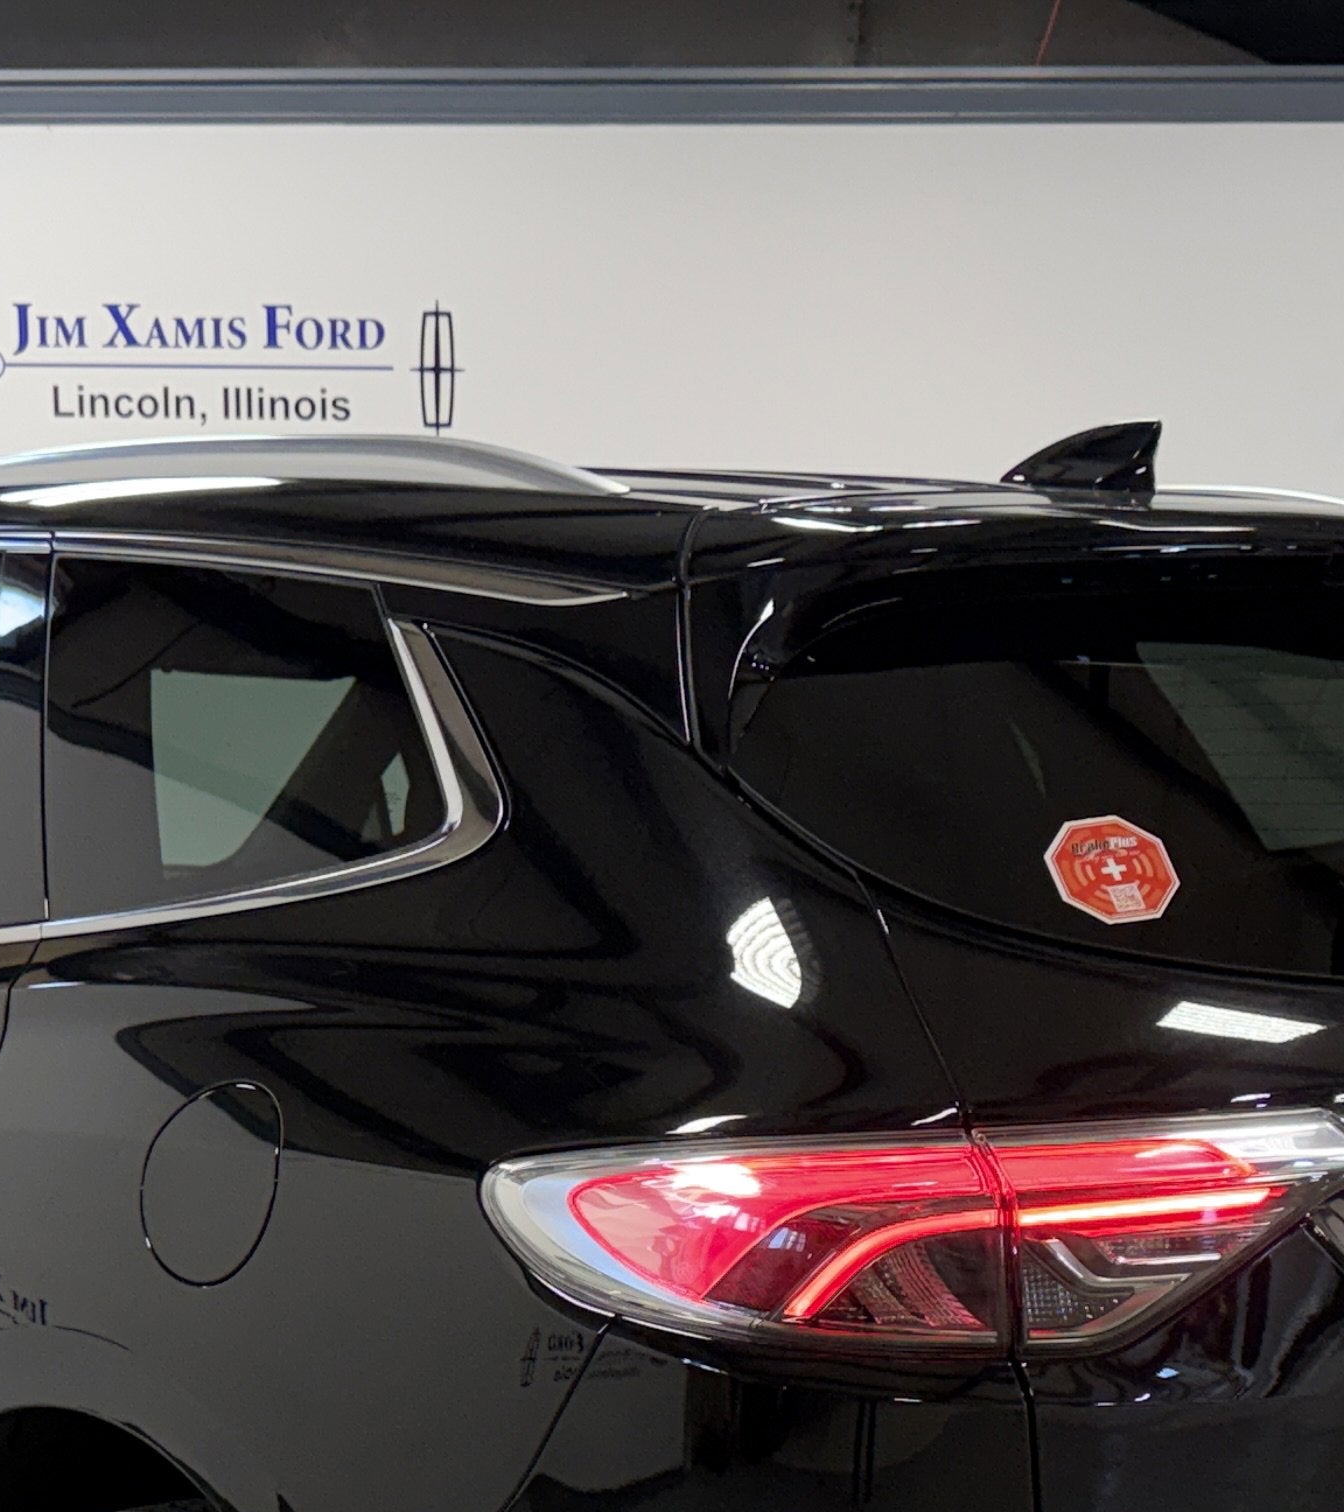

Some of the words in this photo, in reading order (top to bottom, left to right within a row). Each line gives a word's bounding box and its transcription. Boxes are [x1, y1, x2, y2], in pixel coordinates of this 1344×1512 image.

[12, 302, 88, 356] JIM
[102, 303, 247, 350] XAMIS
[262, 304, 386, 351] FORD
[52, 384, 207, 426] Lincoln,
[222, 386, 351, 422] Illinois
